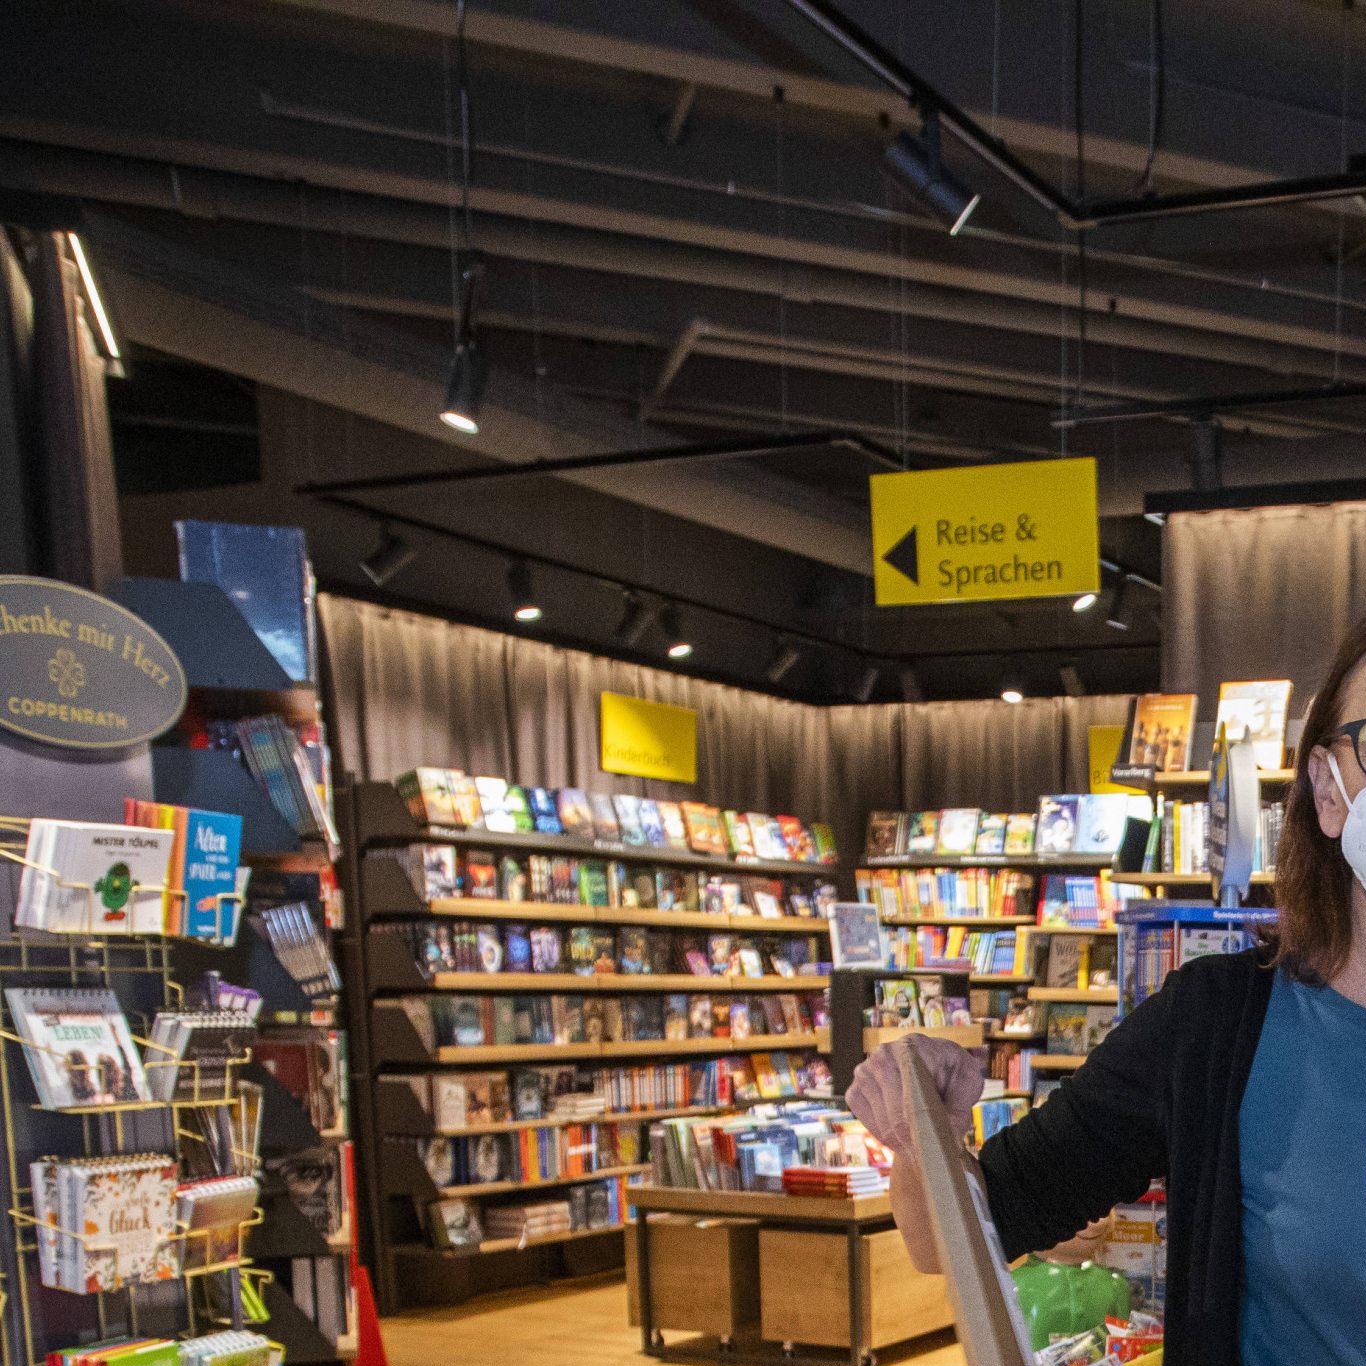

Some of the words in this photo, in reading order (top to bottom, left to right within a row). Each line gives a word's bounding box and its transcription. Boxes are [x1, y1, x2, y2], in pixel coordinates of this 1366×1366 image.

[936, 516, 1005, 545] Reise
[1014, 512, 1038, 542] &
[938, 554, 1063, 593] Sprachen
[0, 604, 73, 639] henke
[7, 695, 129, 730] COPPENRATH
